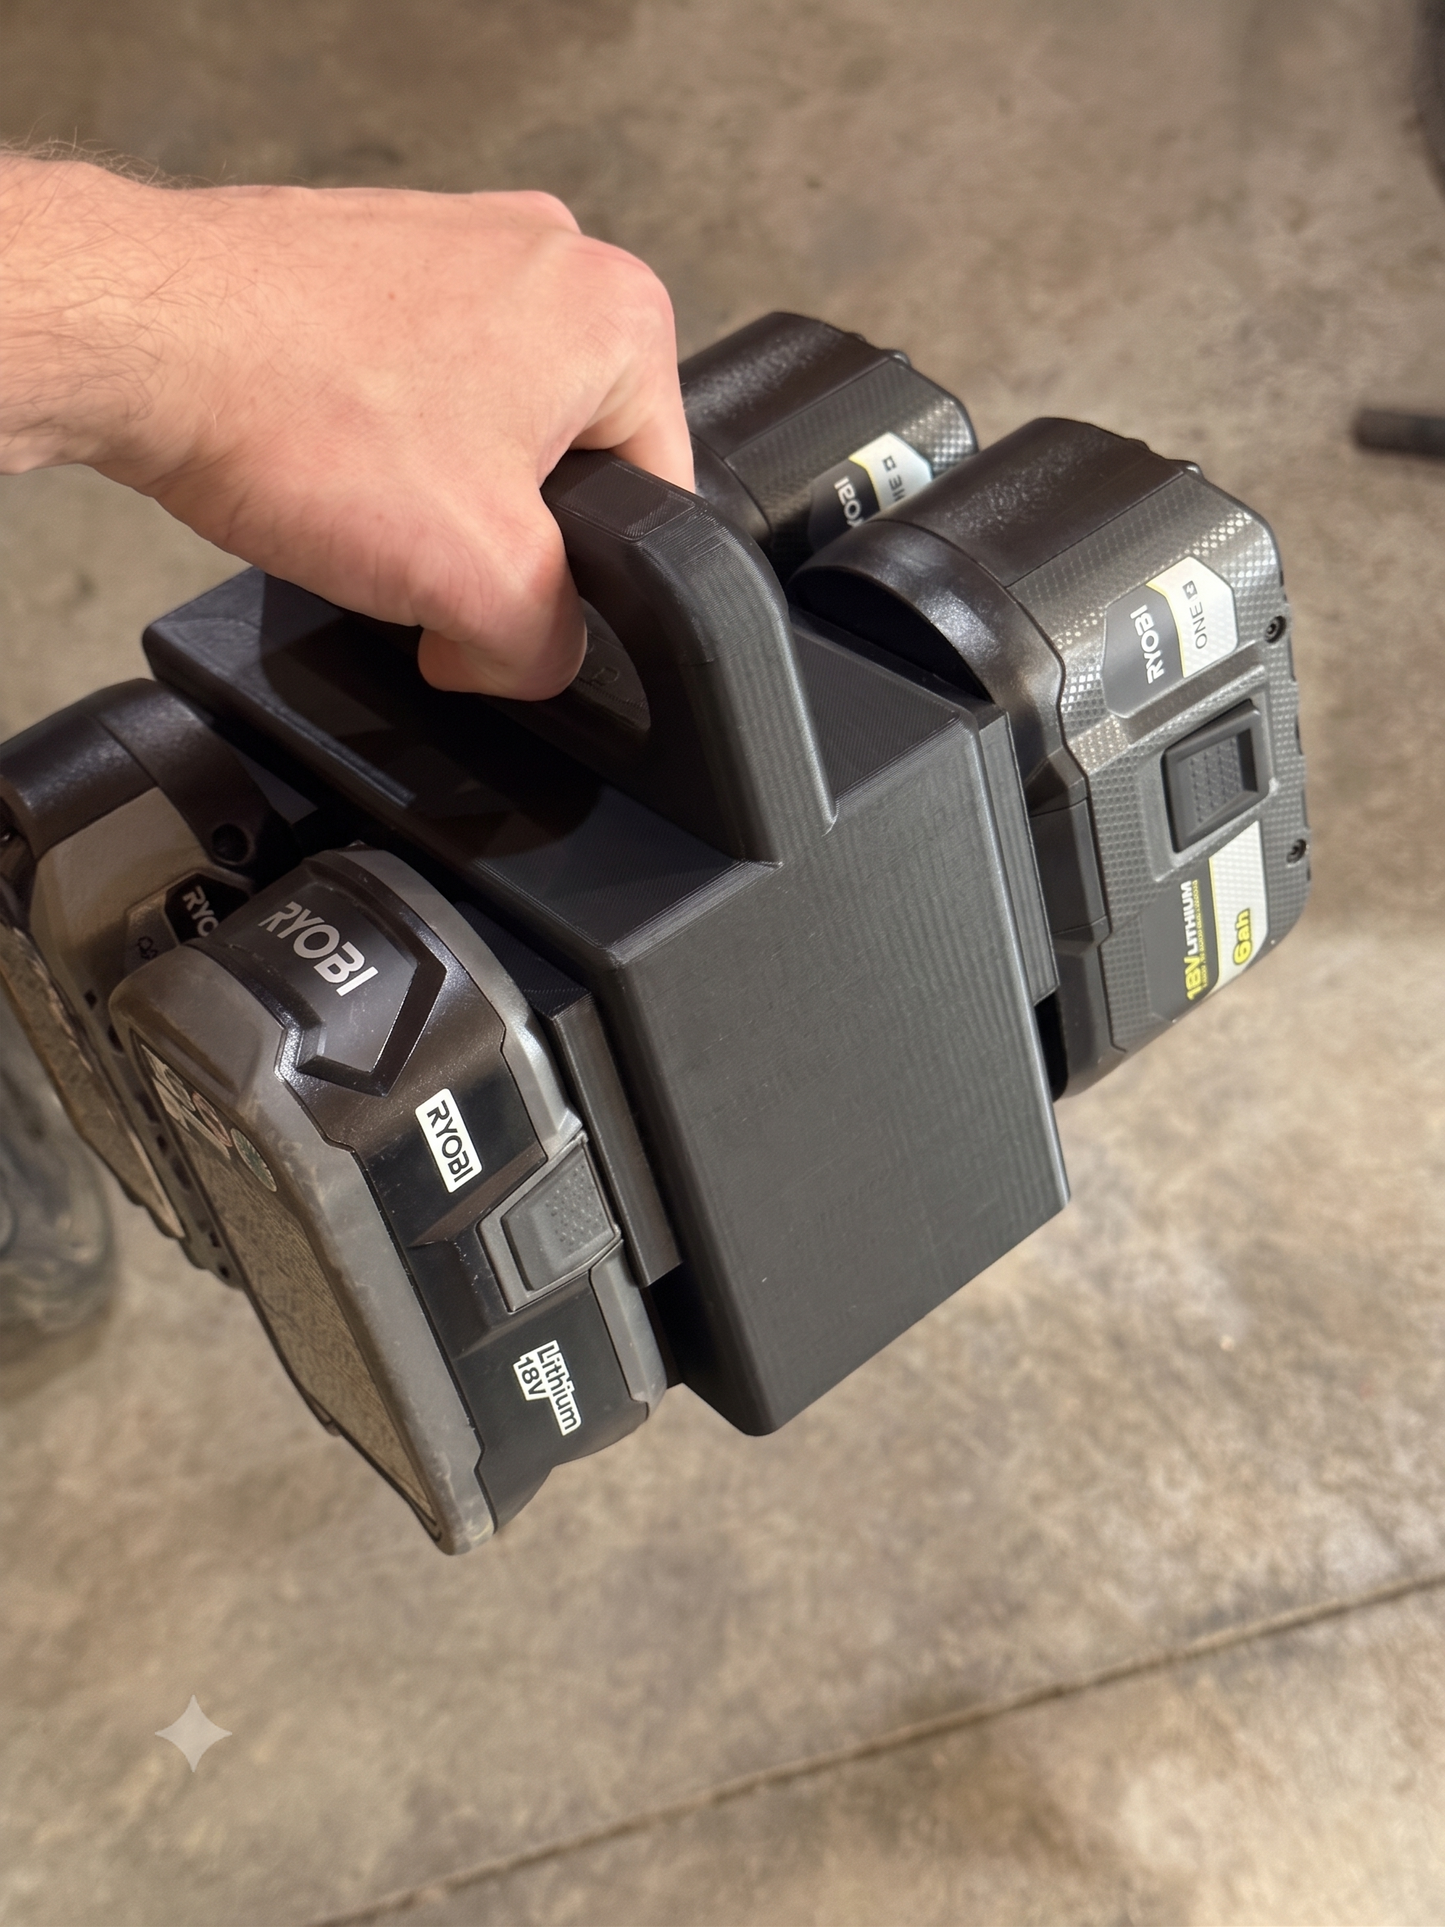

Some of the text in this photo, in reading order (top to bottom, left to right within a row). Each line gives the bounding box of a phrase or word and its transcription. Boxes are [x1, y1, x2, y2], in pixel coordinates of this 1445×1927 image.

[1130, 604, 1166, 685] RYOBI
[182, 885, 219, 937] RYO
[258, 901, 379, 997] RYOBI
[1180, 880, 1199, 956] LITHIUM
[1232, 908, 1253, 966] 6ah
[1183, 950, 1203, 1001] 18V
[426, 1099, 474, 1184] RYOBI
[518, 1357, 546, 1395] 18V
[537, 1345, 577, 1429] Lithium
